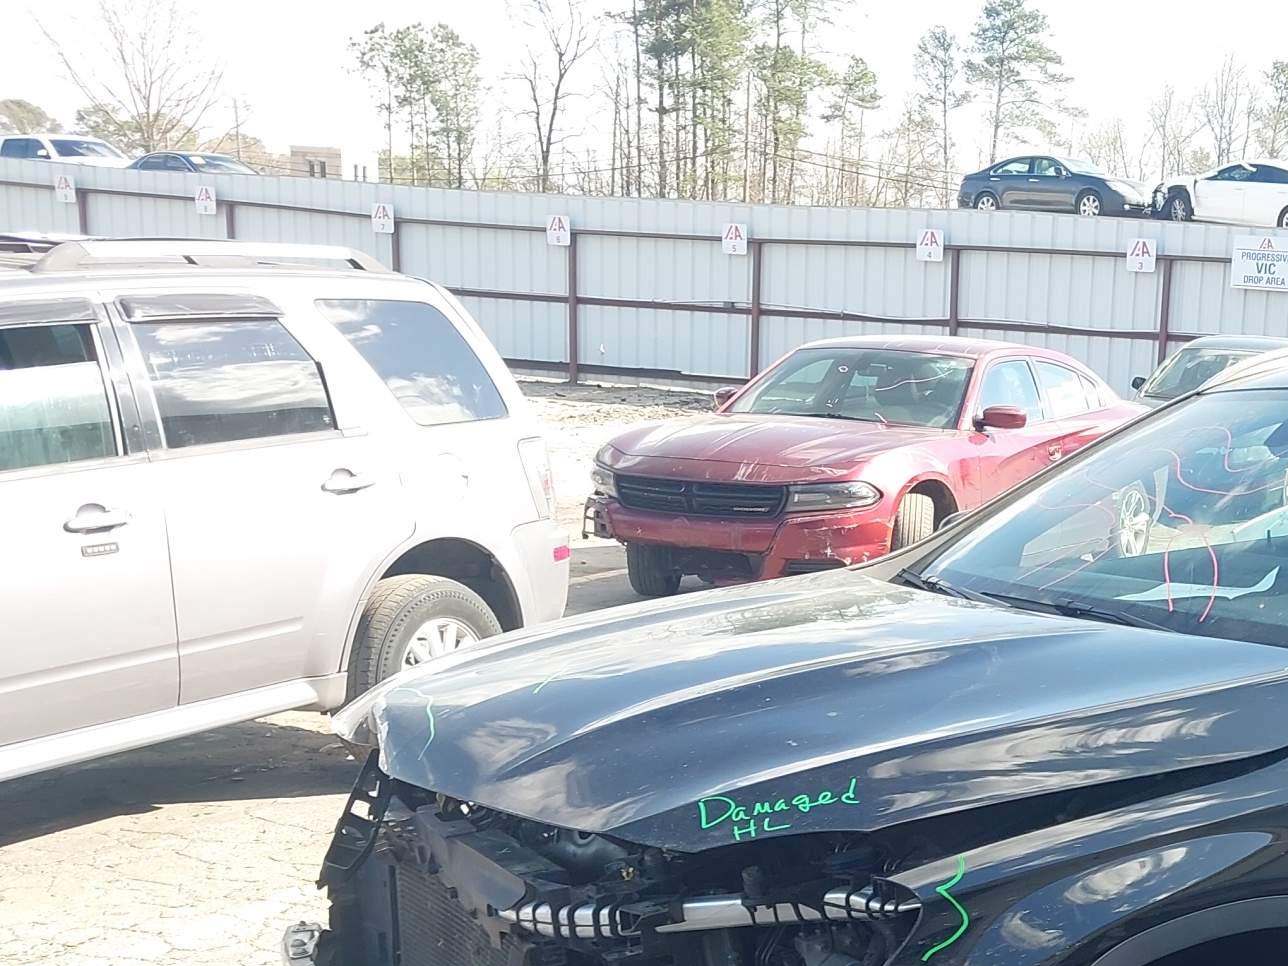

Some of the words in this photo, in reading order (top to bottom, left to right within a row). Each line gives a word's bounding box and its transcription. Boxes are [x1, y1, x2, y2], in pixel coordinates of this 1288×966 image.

[1256, 262, 1277, 275] VIC
[1243, 275, 1264, 285] DROP
[1265, 276, 1286, 286] AREA
[698, 778, 860, 829] Damaged
